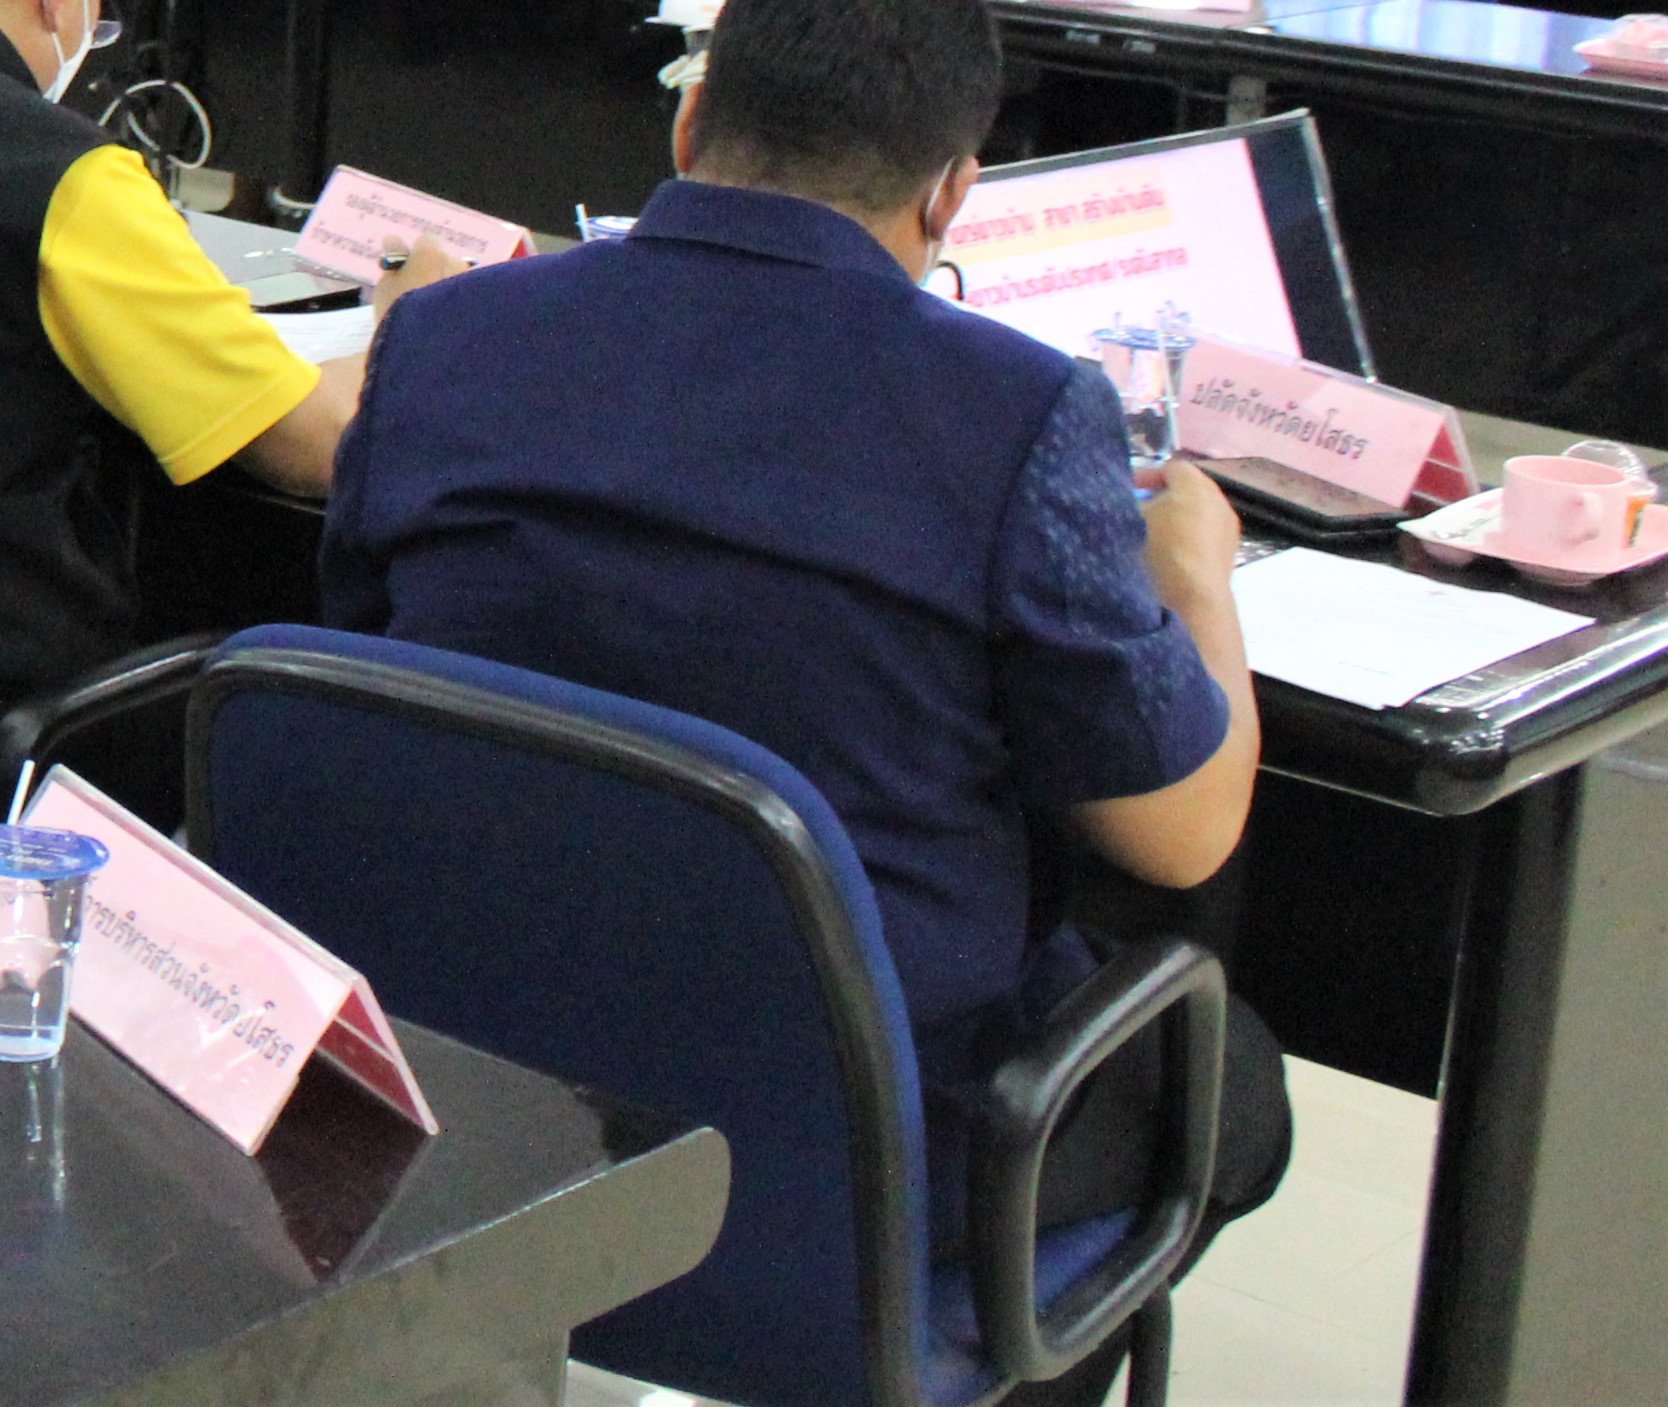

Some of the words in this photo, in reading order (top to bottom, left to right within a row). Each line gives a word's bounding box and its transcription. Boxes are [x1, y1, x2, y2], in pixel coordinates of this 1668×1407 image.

[1189, 377, 1370, 461] ปลัดจังหวัดยโสธร
